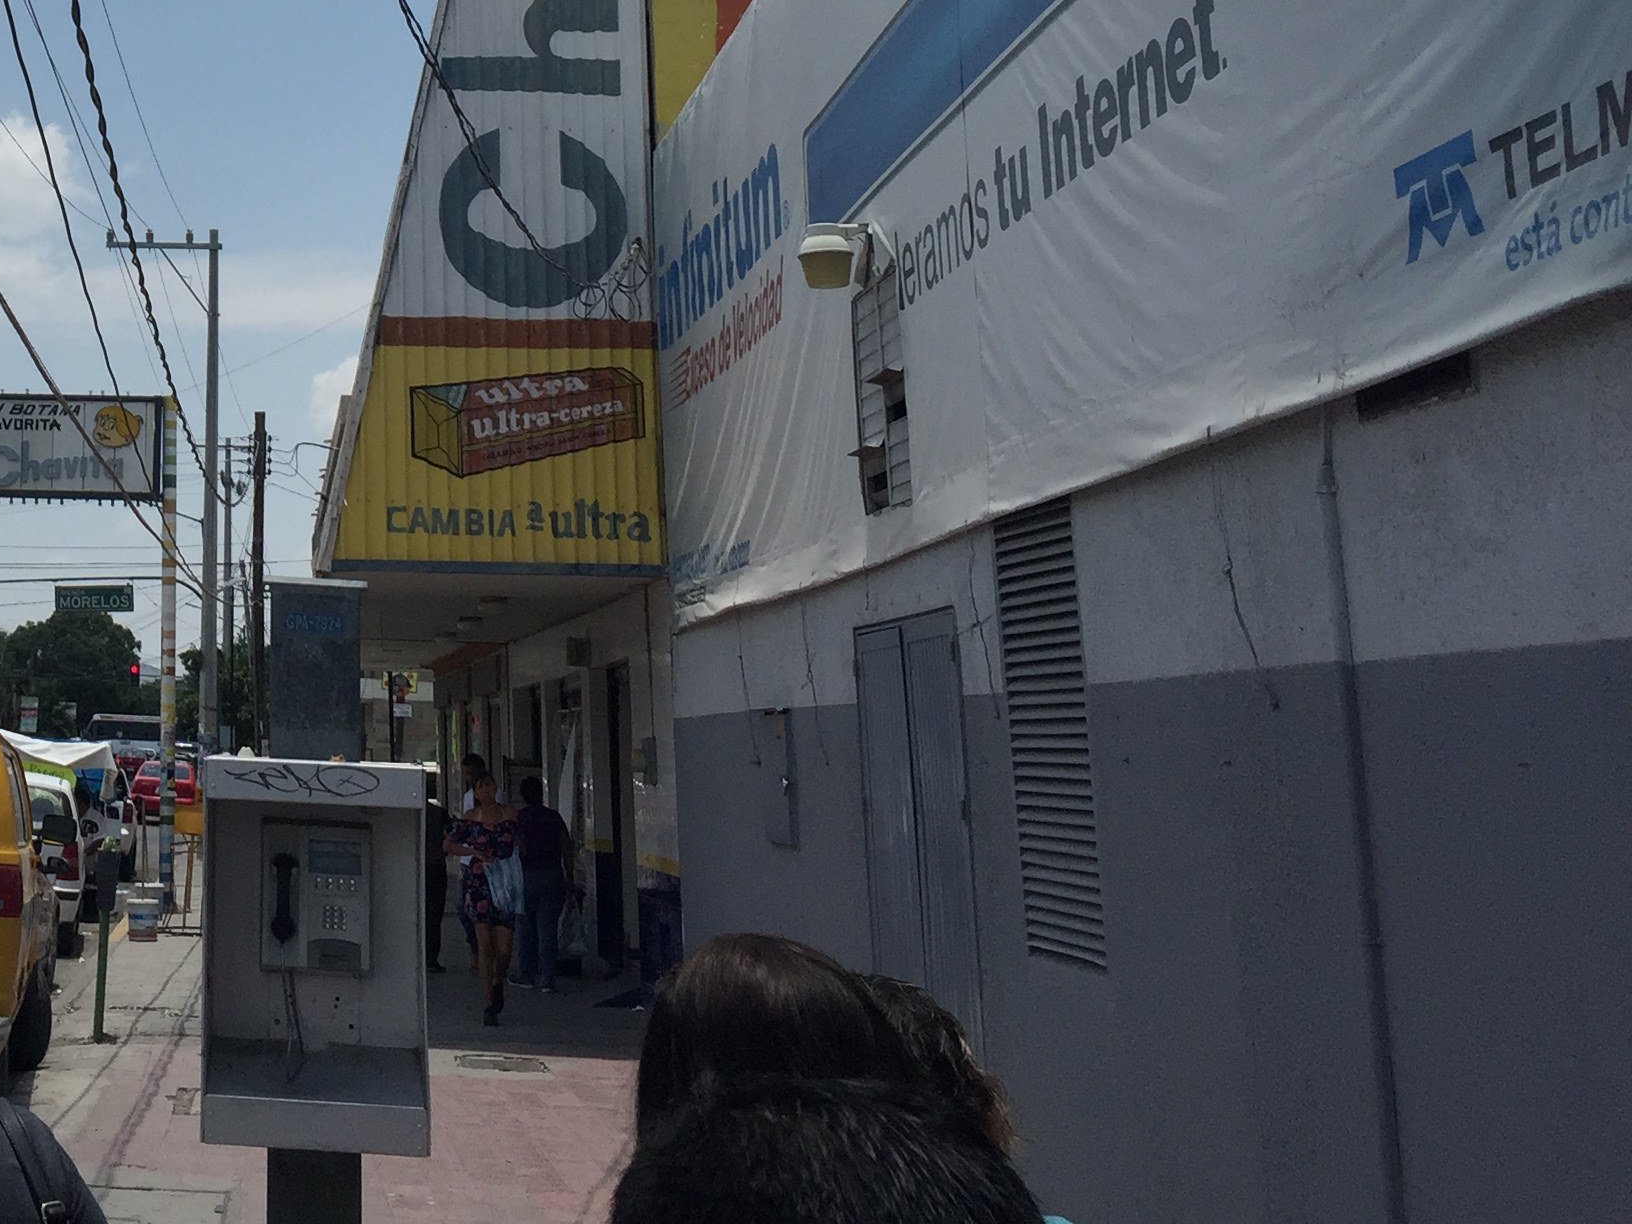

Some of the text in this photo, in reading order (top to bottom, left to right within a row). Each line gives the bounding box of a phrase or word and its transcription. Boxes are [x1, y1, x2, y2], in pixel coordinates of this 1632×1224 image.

[993, 145, 1032, 231] tu
[657, 142, 783, 352] infinitum
[1504, 200, 1562, 272] está
[718, 313, 732, 376] de
[732, 254, 784, 364] Velocidad
[9, 403, 82, 416] BOTANA
[474, 376, 589, 405] ultra
[470, 399, 624, 439] ultra-cereza
[386, 505, 517, 538] CAMBIA
[548, 497, 652, 542] ultra
[59, 594, 130, 609] MORELOS
